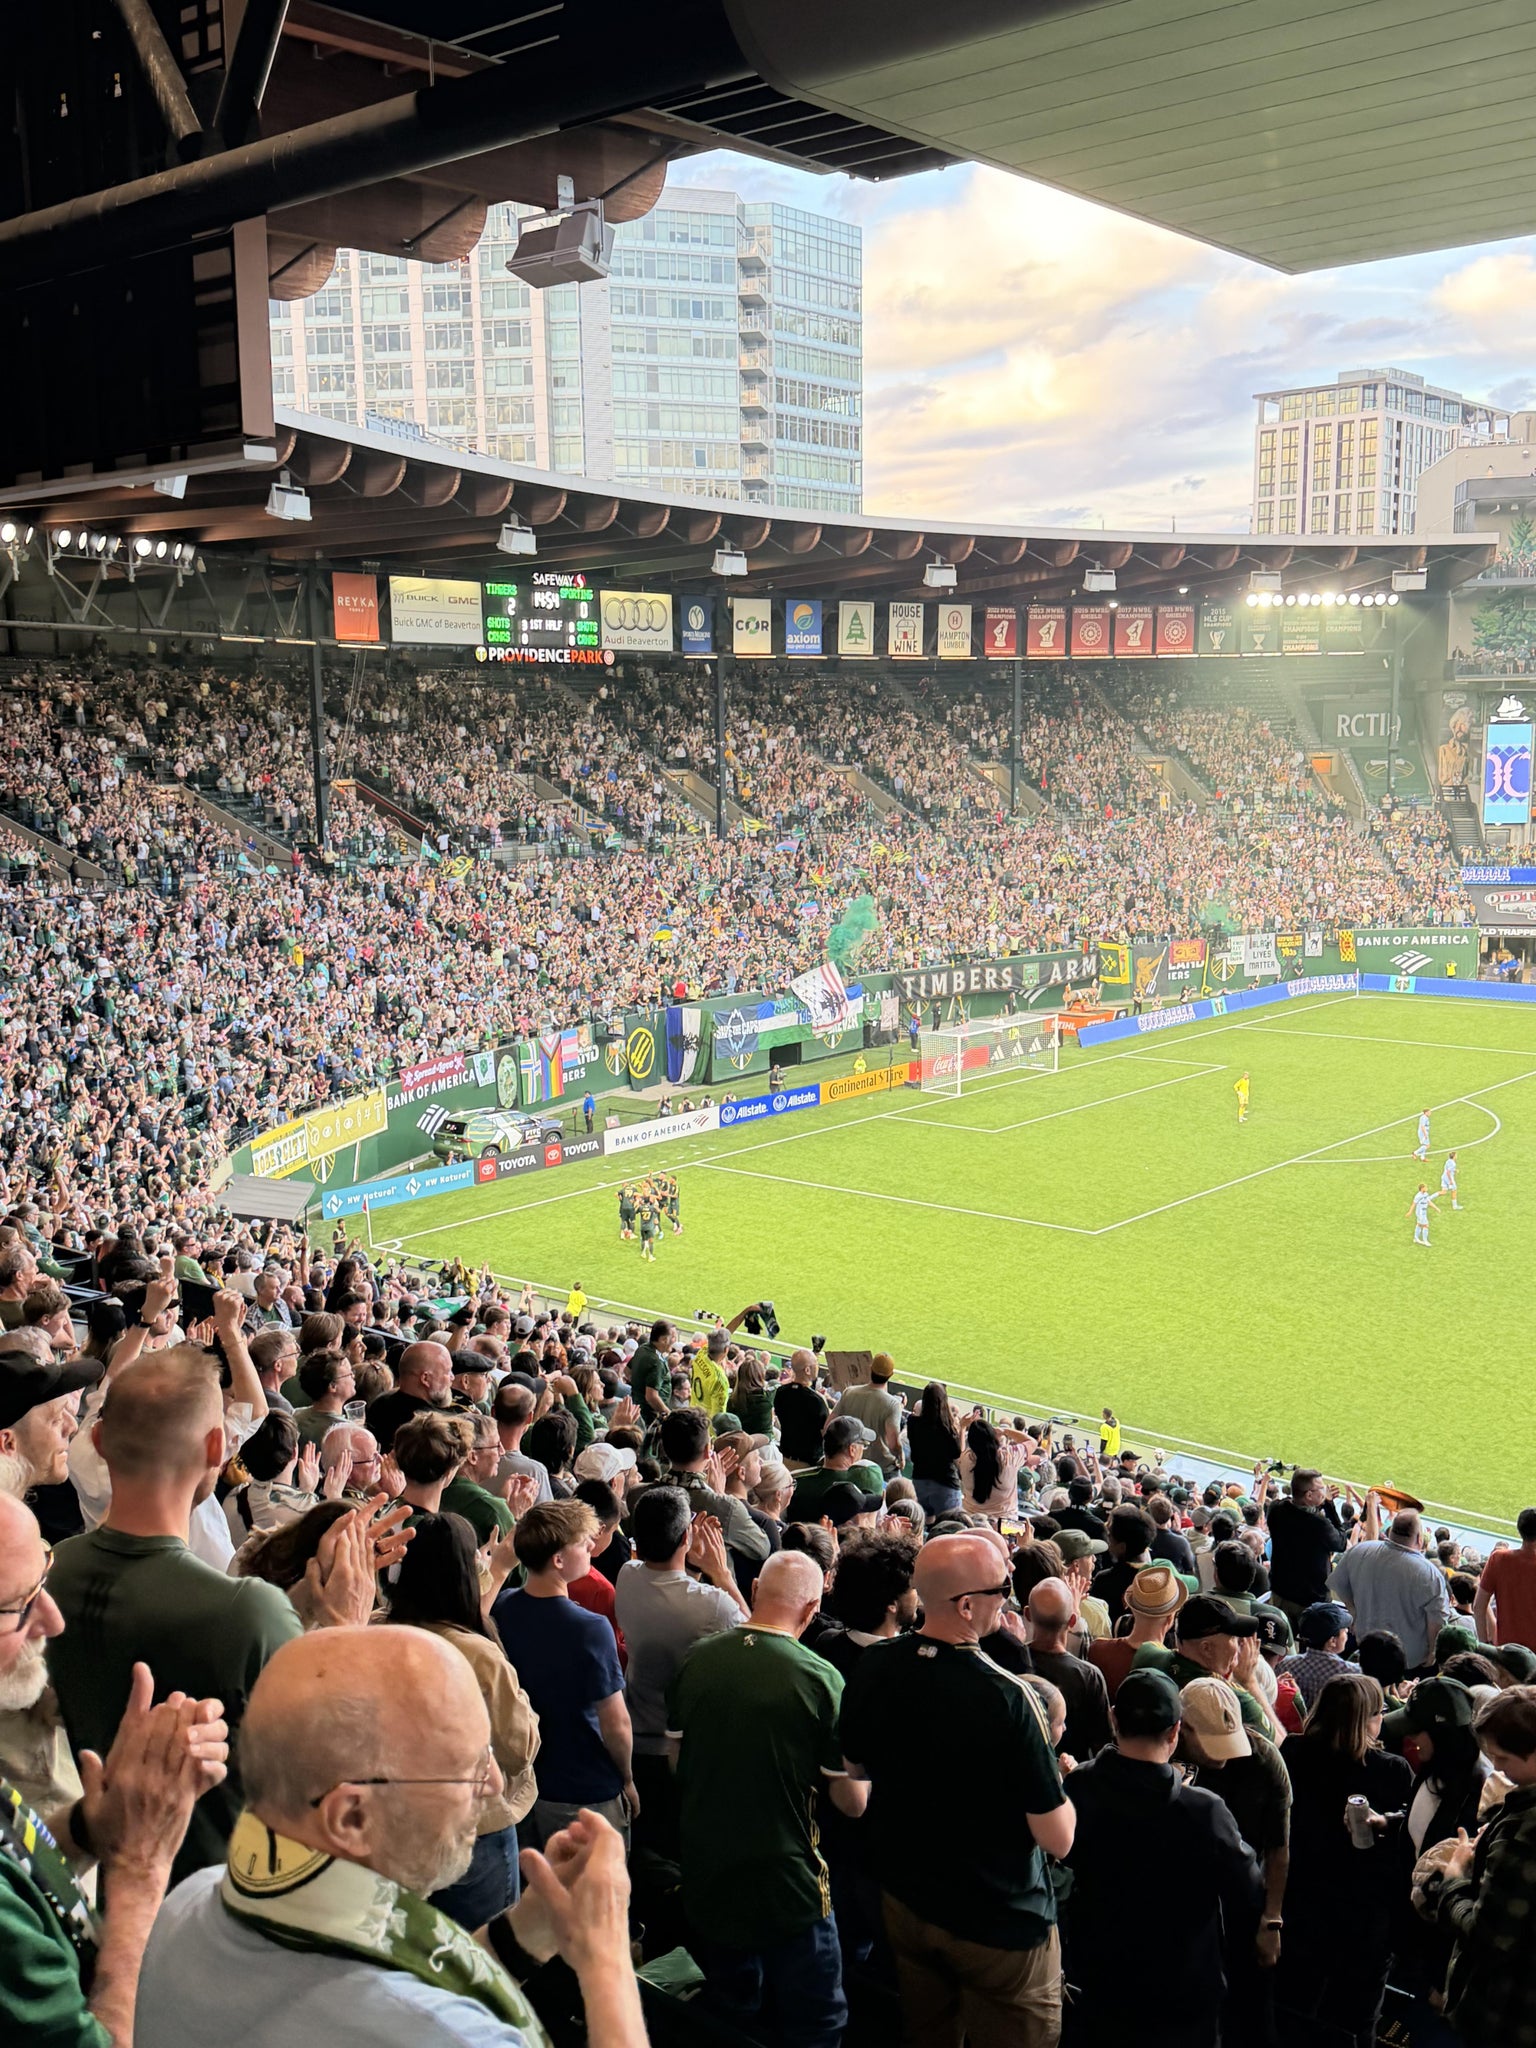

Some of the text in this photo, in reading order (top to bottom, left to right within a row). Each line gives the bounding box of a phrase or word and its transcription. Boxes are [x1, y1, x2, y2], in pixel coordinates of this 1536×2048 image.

[532, 573, 574, 587] SAFEWAY
[486, 583, 517, 596] TIMBERS
[560, 588, 593, 600] SPORTING
[337, 595, 375, 608] REYKA
[406, 594, 479, 606] BUICK GMC
[508, 597, 516, 616] 2
[580, 601, 588, 618] 0
[892, 604, 921, 618] HOUSE
[394, 617, 481, 630] Buick GMC of Beaverton
[487, 617, 510, 629] SHOTS
[530, 619, 563, 631] 1ST HALF
[576, 621, 598, 633] SHOTS
[604, 636, 668, 645] Audi Beaverton
[787, 632, 820, 643] axiom
[939, 631, 970, 640] HAMPTON
[894, 640, 918, 653] WINE
[943, 641, 965, 649] LUMBER
[488, 647, 604, 665] PROVIDENCE PARK
[1356, 935, 1469, 946] BANK OF AMERICA
[1253, 951, 1272, 959] LIVES
[1249, 961, 1276, 969] MATTER
[902, 966, 1013, 1000] TIMBERS
[387, 1069, 476, 1110] BANK OF AMERICA
[828, 1069, 904, 1099] Continental Tire
[787, 1092, 817, 1107] Allstate
[736, 1103, 767, 1119] Allstate
[615, 1122, 692, 1146] BANK OF AMERICA
[563, 1140, 600, 1157] TOYOTA
[498, 1155, 537, 1171] TOYOTA
[425, 1170, 471, 1187] NW Natural
[347, 1187, 397, 1204] NW Natural
